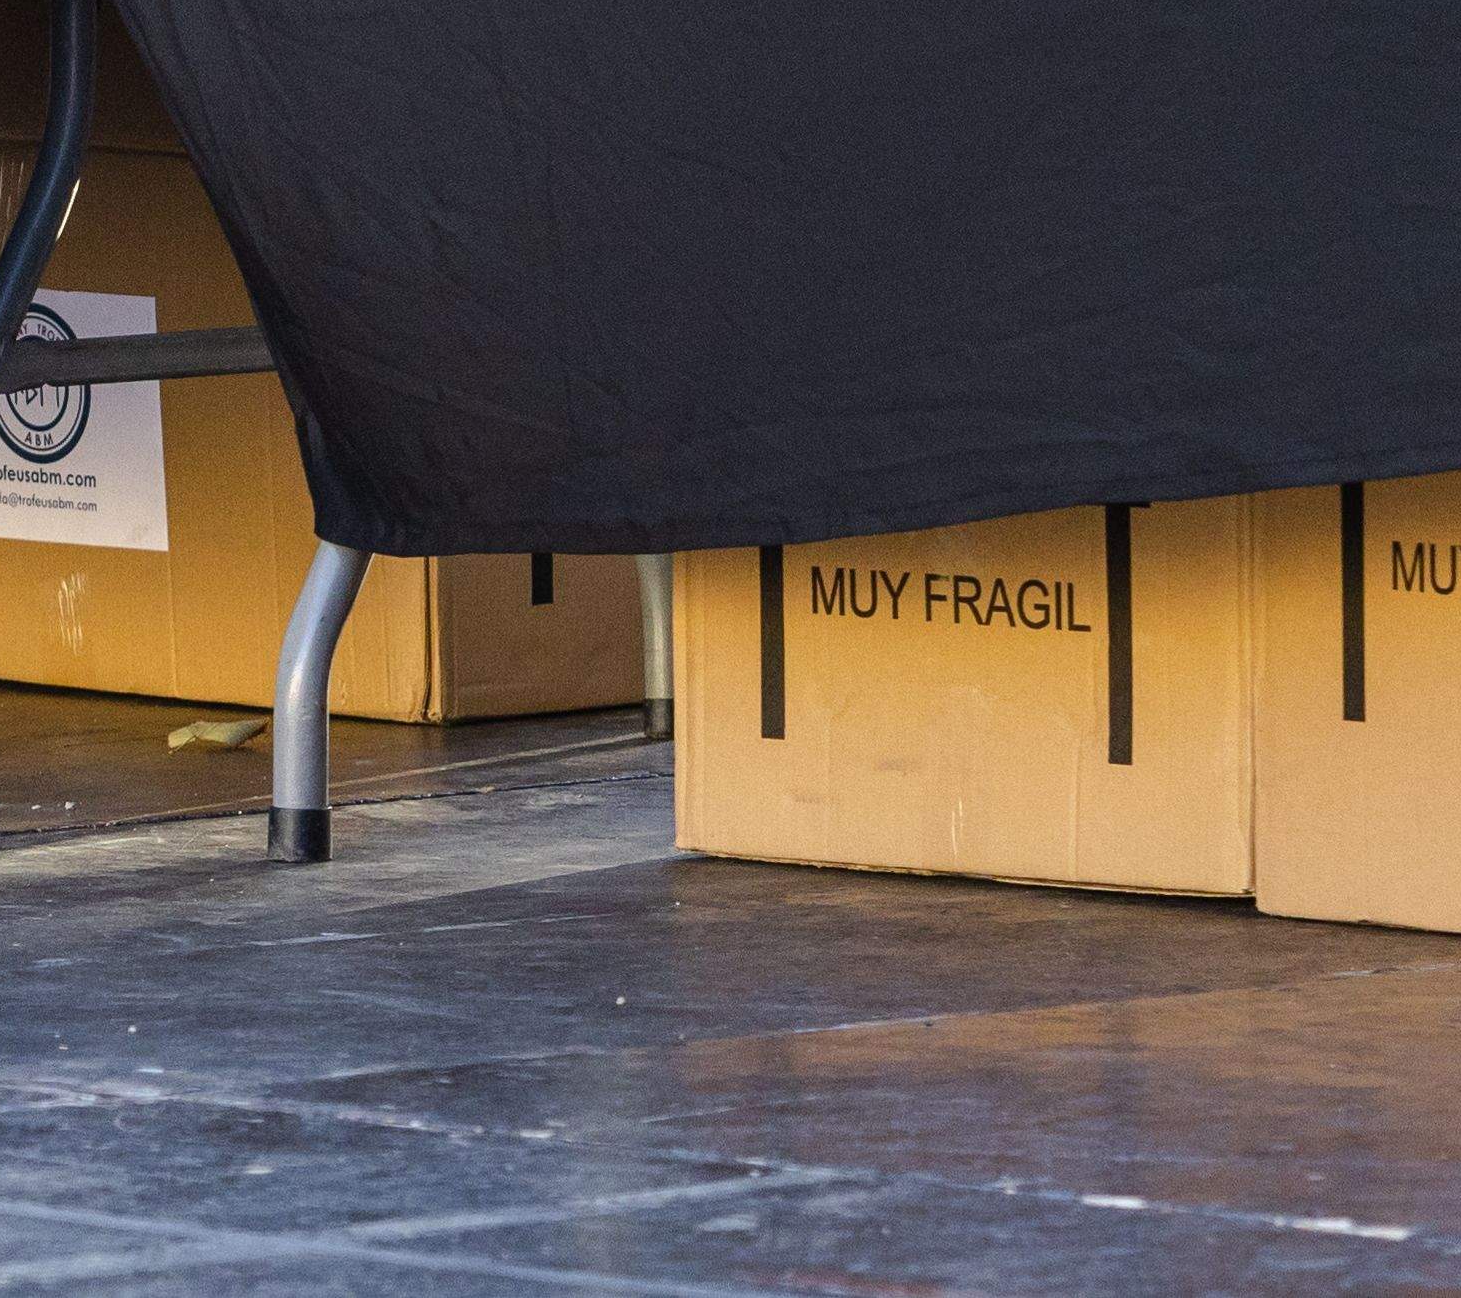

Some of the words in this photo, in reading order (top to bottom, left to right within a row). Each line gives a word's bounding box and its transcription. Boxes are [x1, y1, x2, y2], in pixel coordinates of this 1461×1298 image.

[25, 432, 54, 446] ABM
[811, 566, 910, 623] MUY
[924, 573, 1092, 633] FRAGIL
